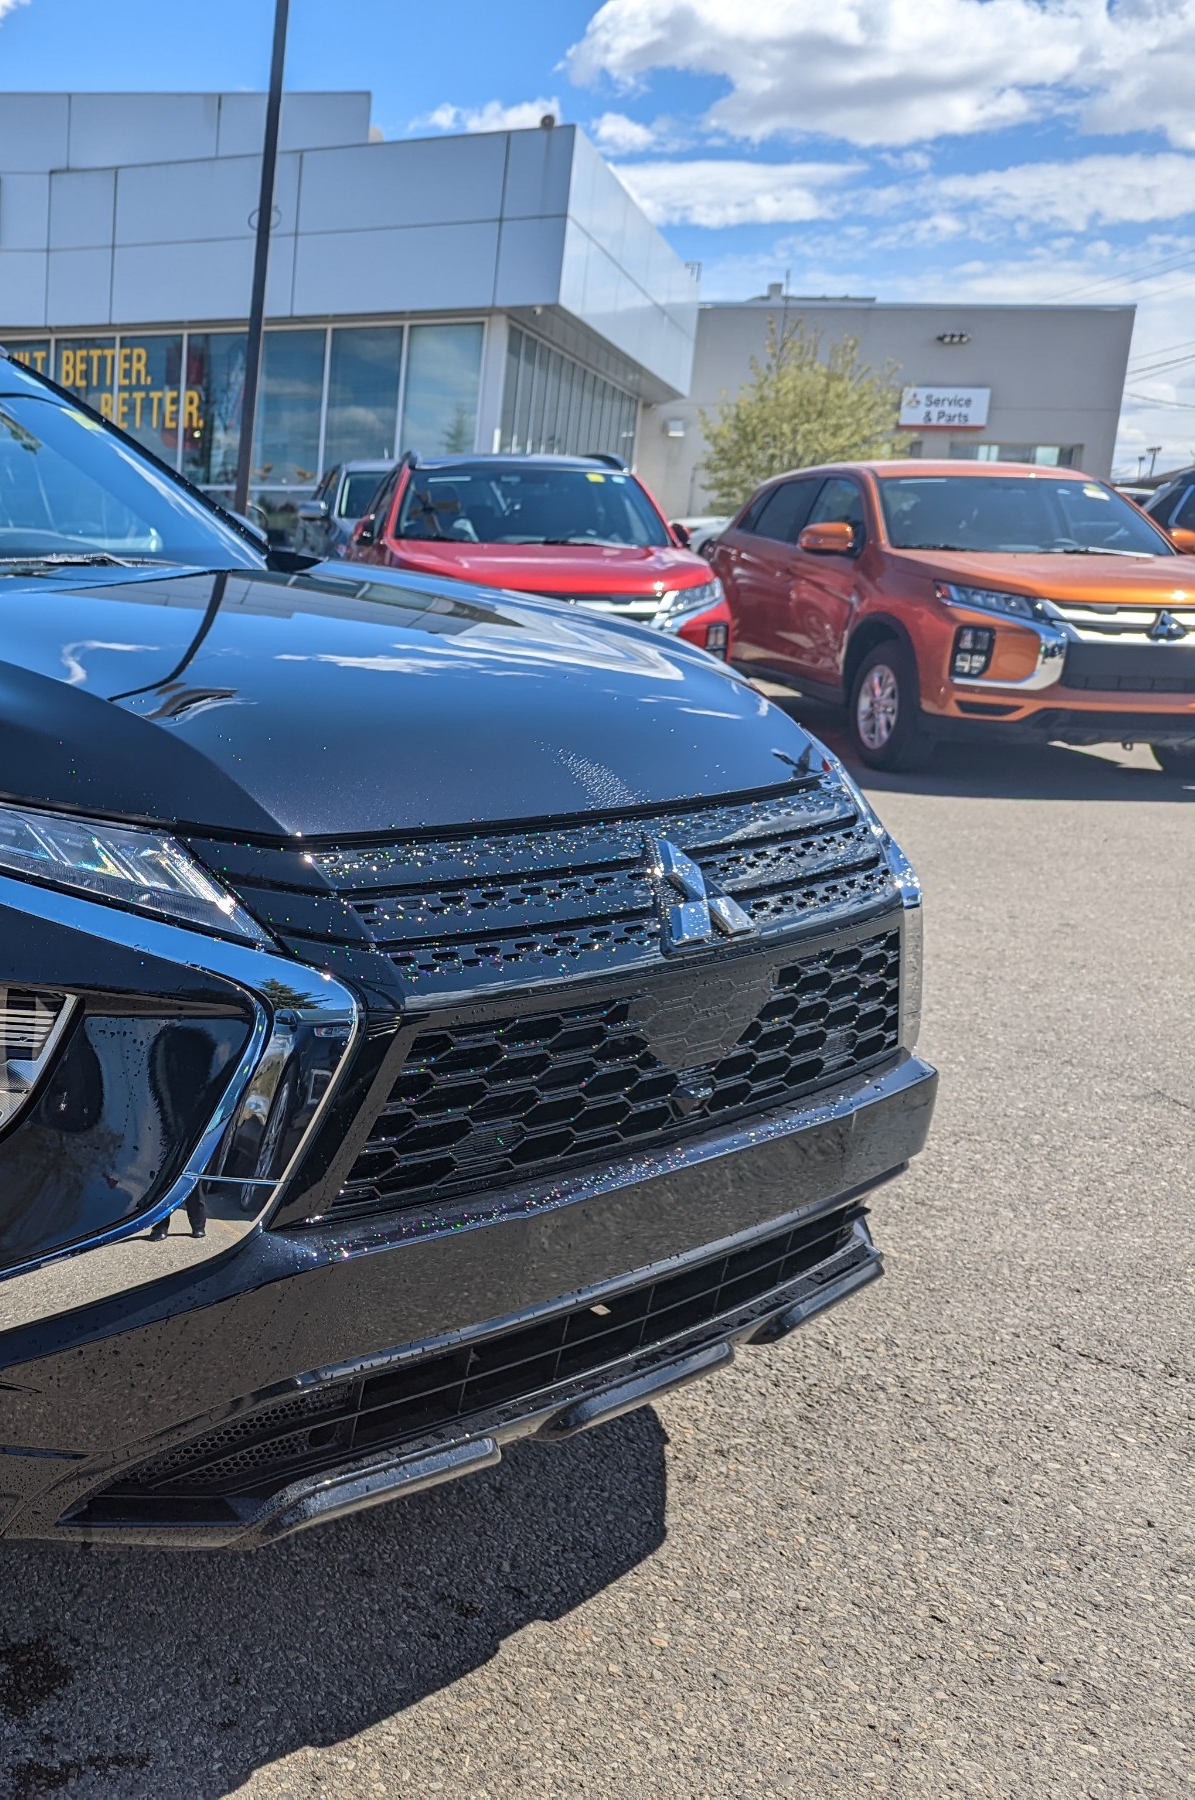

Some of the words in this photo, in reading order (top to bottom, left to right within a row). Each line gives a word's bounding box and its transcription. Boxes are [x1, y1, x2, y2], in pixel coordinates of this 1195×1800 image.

[61, 348, 153, 387] BETTER.
[925, 393, 973, 408] Service
[923, 409, 932, 423] &
[937, 410, 969, 423] Parts
